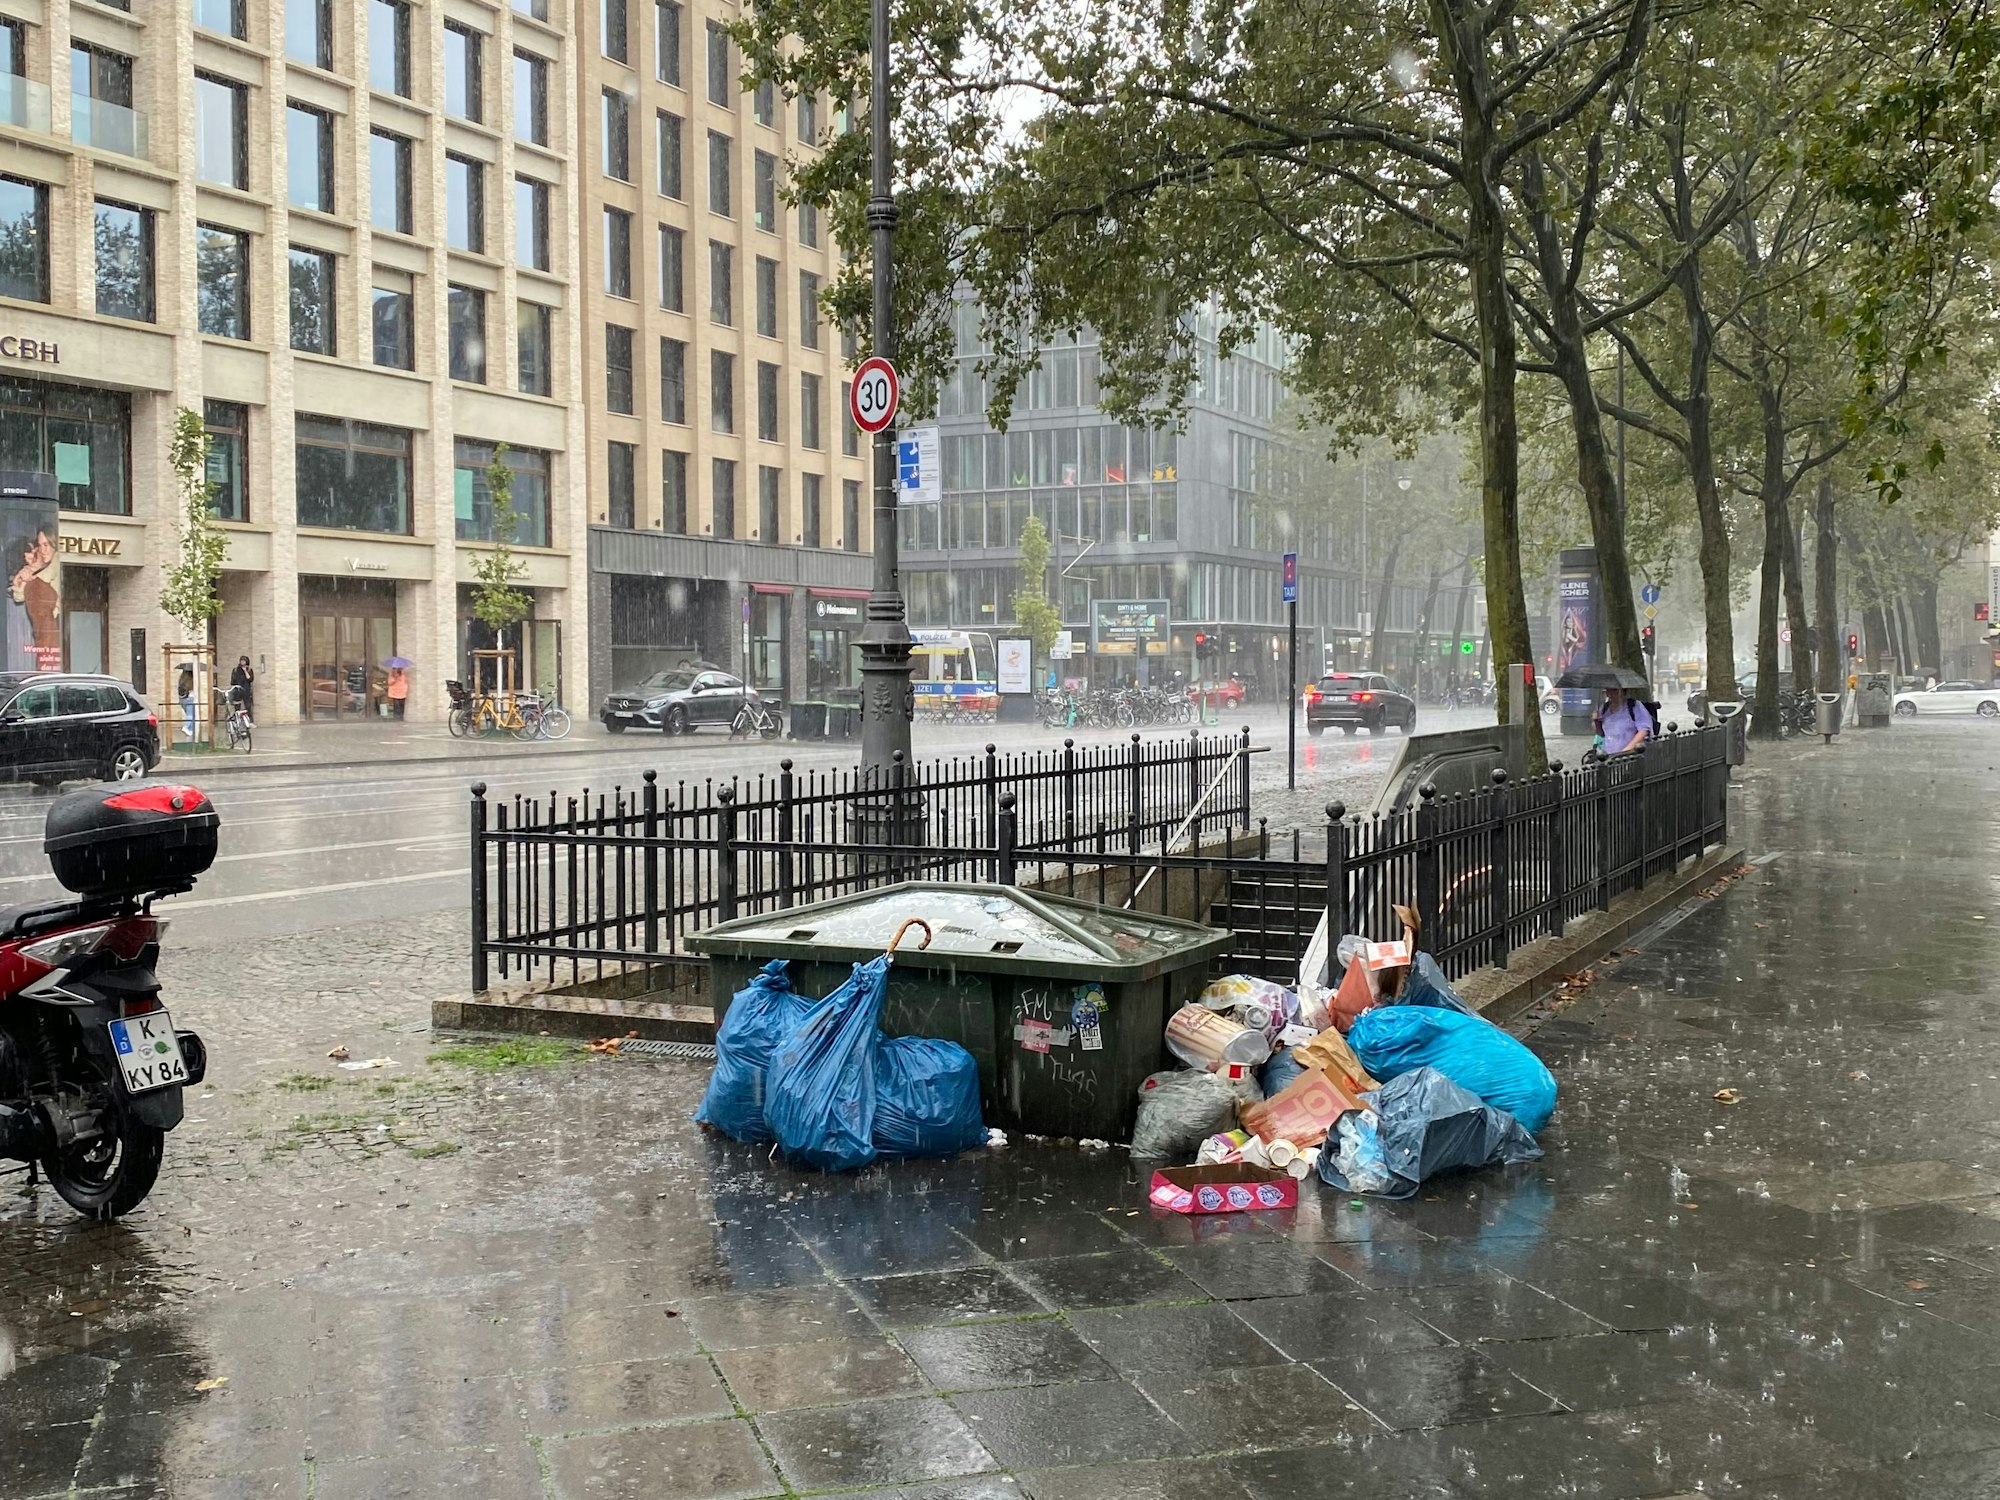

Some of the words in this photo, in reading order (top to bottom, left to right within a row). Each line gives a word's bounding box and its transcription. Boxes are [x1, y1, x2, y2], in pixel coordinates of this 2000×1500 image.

[0, 335, 60, 364] CBH
[861, 378, 887, 412] 30
[920, 633, 948, 641] POLIZEI
[139, 1019, 155, 1039] K
[120, 1041, 129, 1051] D
[127, 1065, 154, 1089] KY
[159, 1059, 184, 1081] 84
